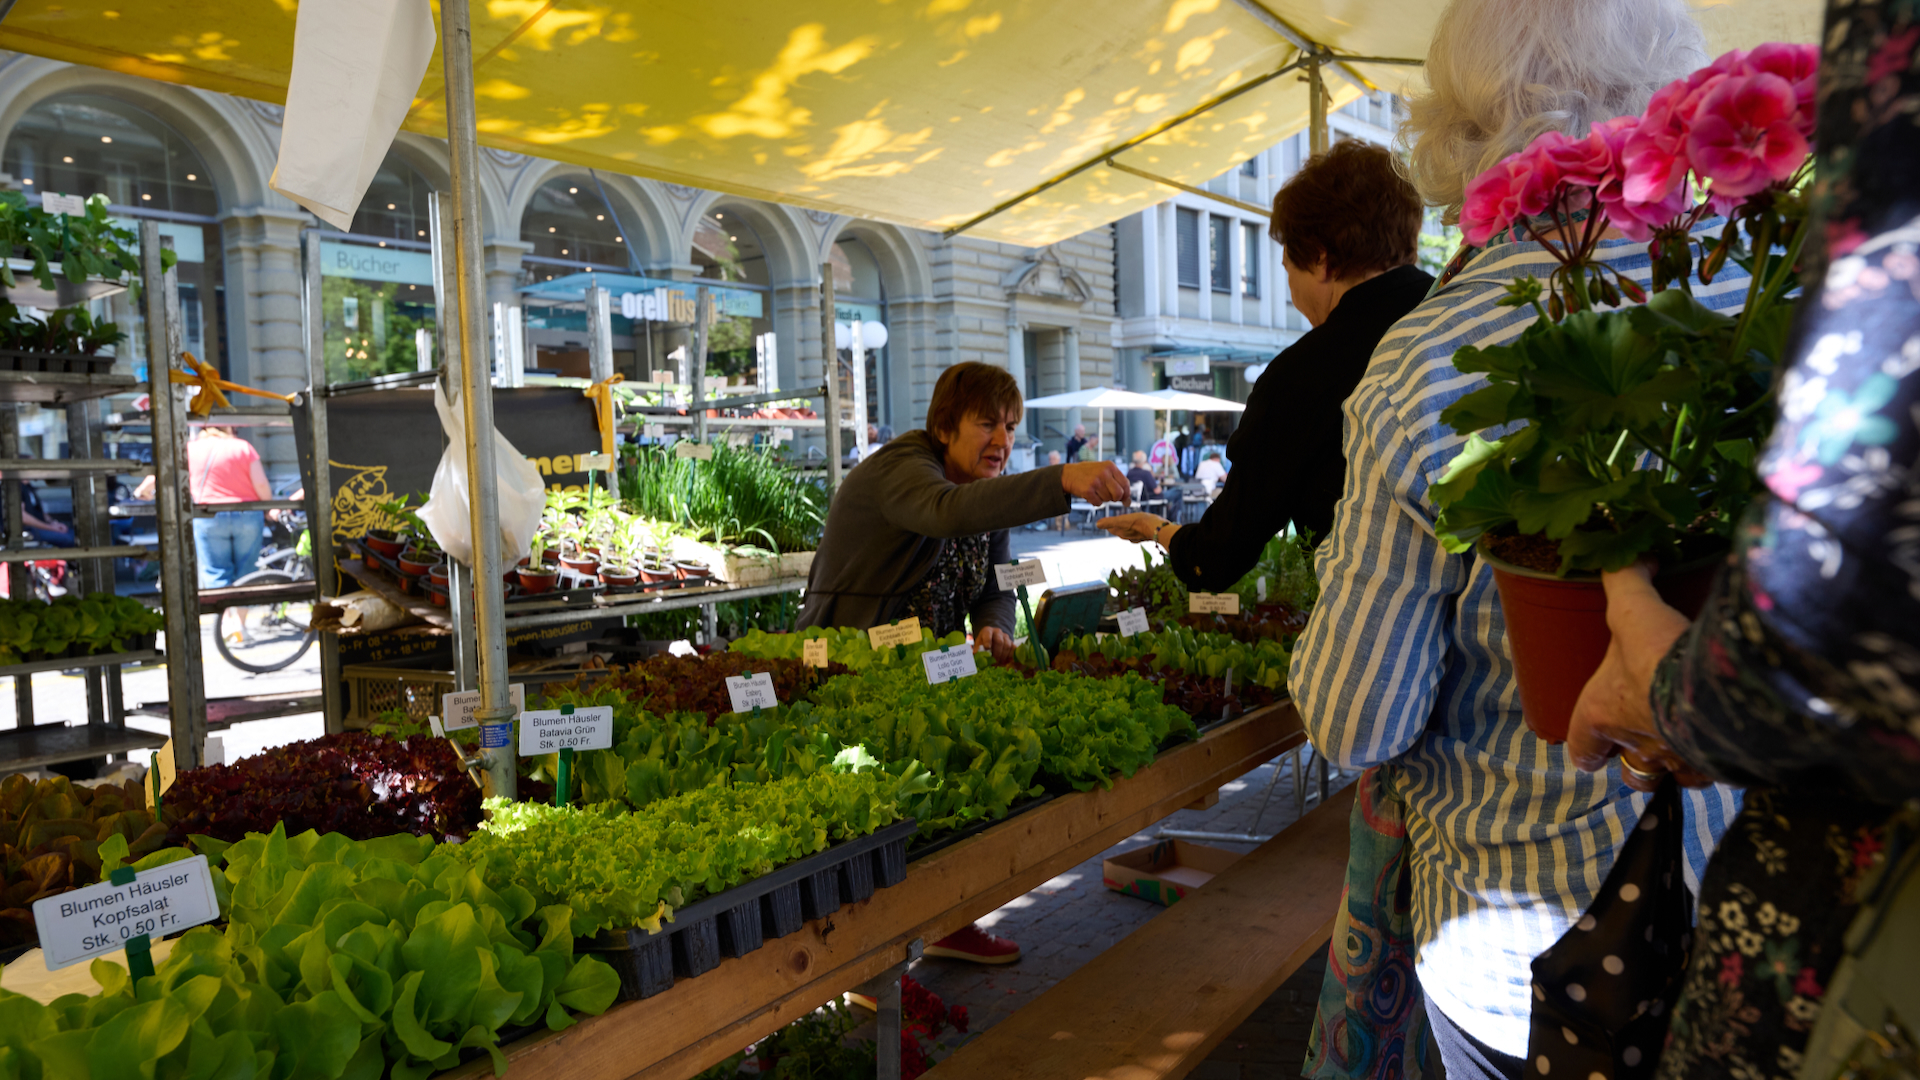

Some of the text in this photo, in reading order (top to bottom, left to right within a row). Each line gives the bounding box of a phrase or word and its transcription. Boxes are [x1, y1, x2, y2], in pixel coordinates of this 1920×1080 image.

[337, 250, 400, 275] Bücher
[1172, 376, 1213, 391] Clochard
[929, 653, 947, 663] Blumen
[461, 715, 477, 724] Stk.
[533, 713, 602, 727] Blumen Häusler
[539, 726, 596, 738] Batavia Grün
[539, 736, 591, 749] Stk. 0.50 Fr.
[60, 872, 190, 918] Blumen Häusler
[92, 896, 170, 928] Kopfsalat
[82, 912, 181, 951] Stk. 0.50 Fr.
